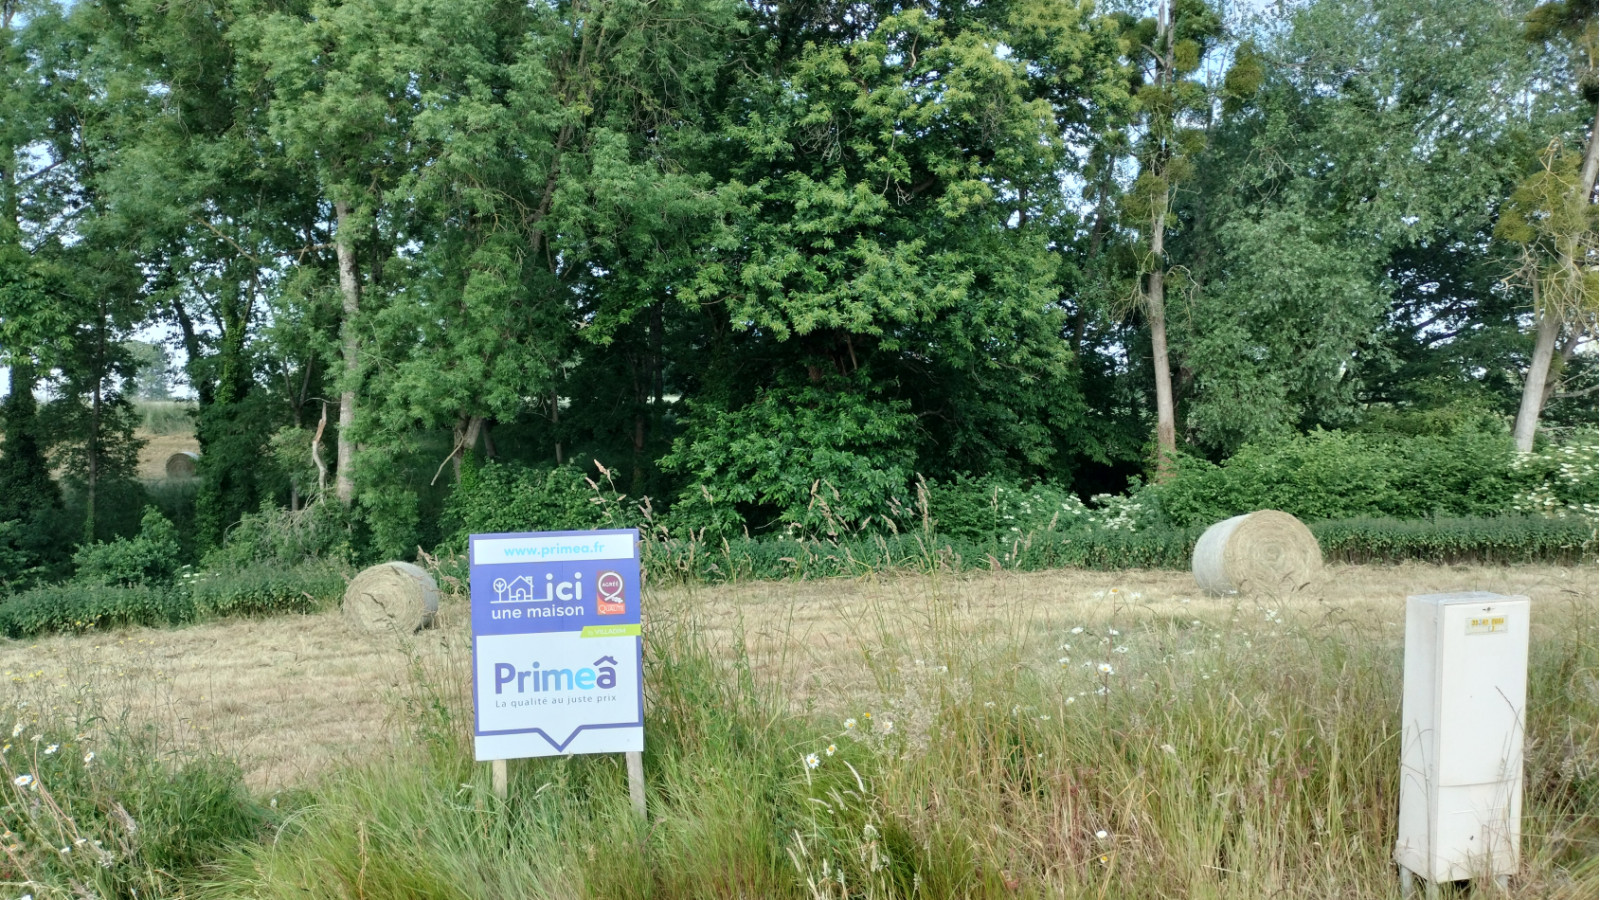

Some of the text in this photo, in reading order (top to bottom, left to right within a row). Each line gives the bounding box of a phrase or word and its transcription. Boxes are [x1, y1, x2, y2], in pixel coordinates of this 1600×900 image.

[504, 541, 605, 557] www.primea.fr
[546, 572, 582, 601] ici
[491, 604, 584, 619] une maison
[495, 700, 507, 708] La
[511, 696, 548, 708] qualité
[567, 695, 593, 705] juste
[597, 694, 617, 703] prix
